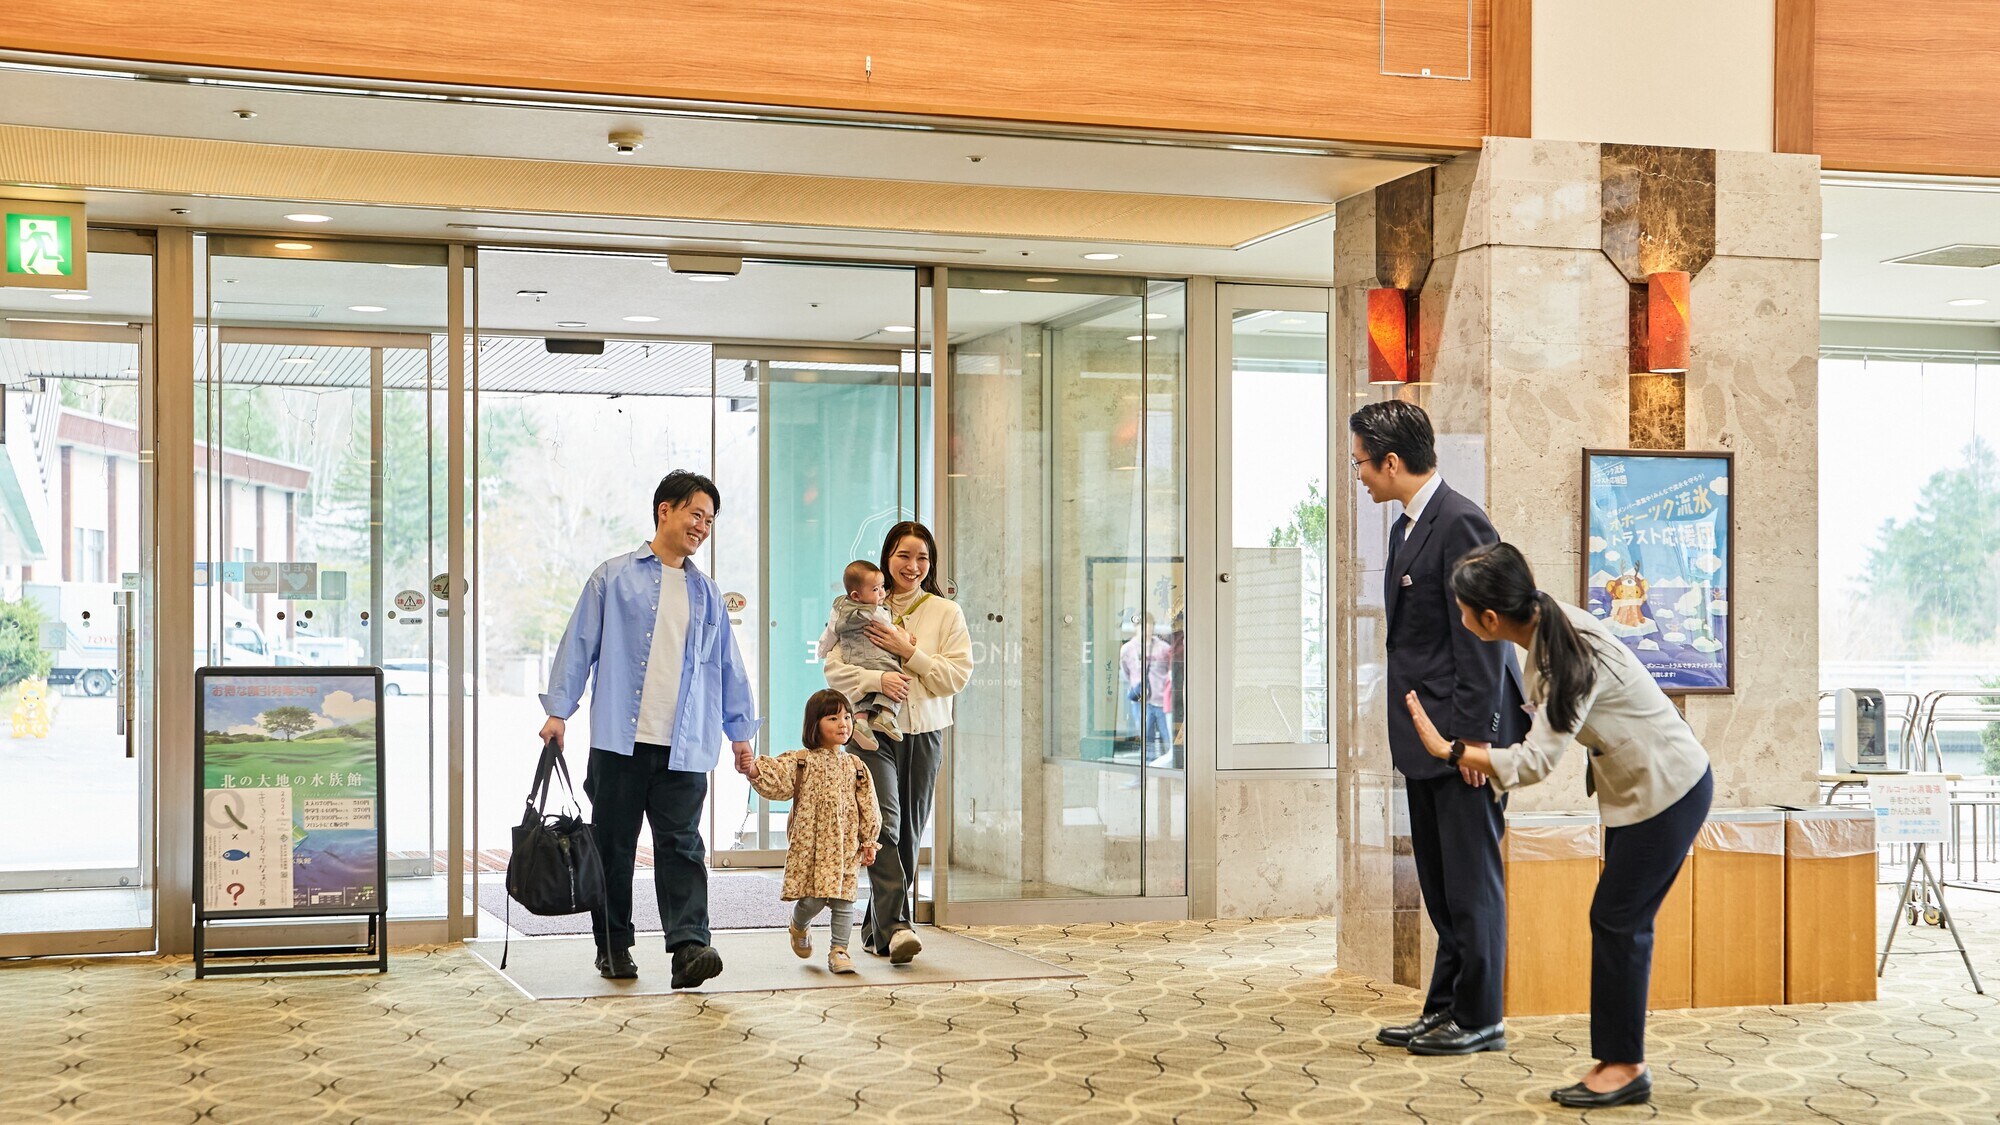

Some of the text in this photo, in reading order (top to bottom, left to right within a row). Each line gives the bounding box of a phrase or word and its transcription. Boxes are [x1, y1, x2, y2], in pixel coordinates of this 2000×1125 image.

[1609, 484, 1712, 532] オホーツク流氷
[1612, 521, 1717, 549] トラスト応援団
[220, 772, 362, 788] 北の大地の水族館
[1877, 784, 1942, 794] アルコール消毒液
